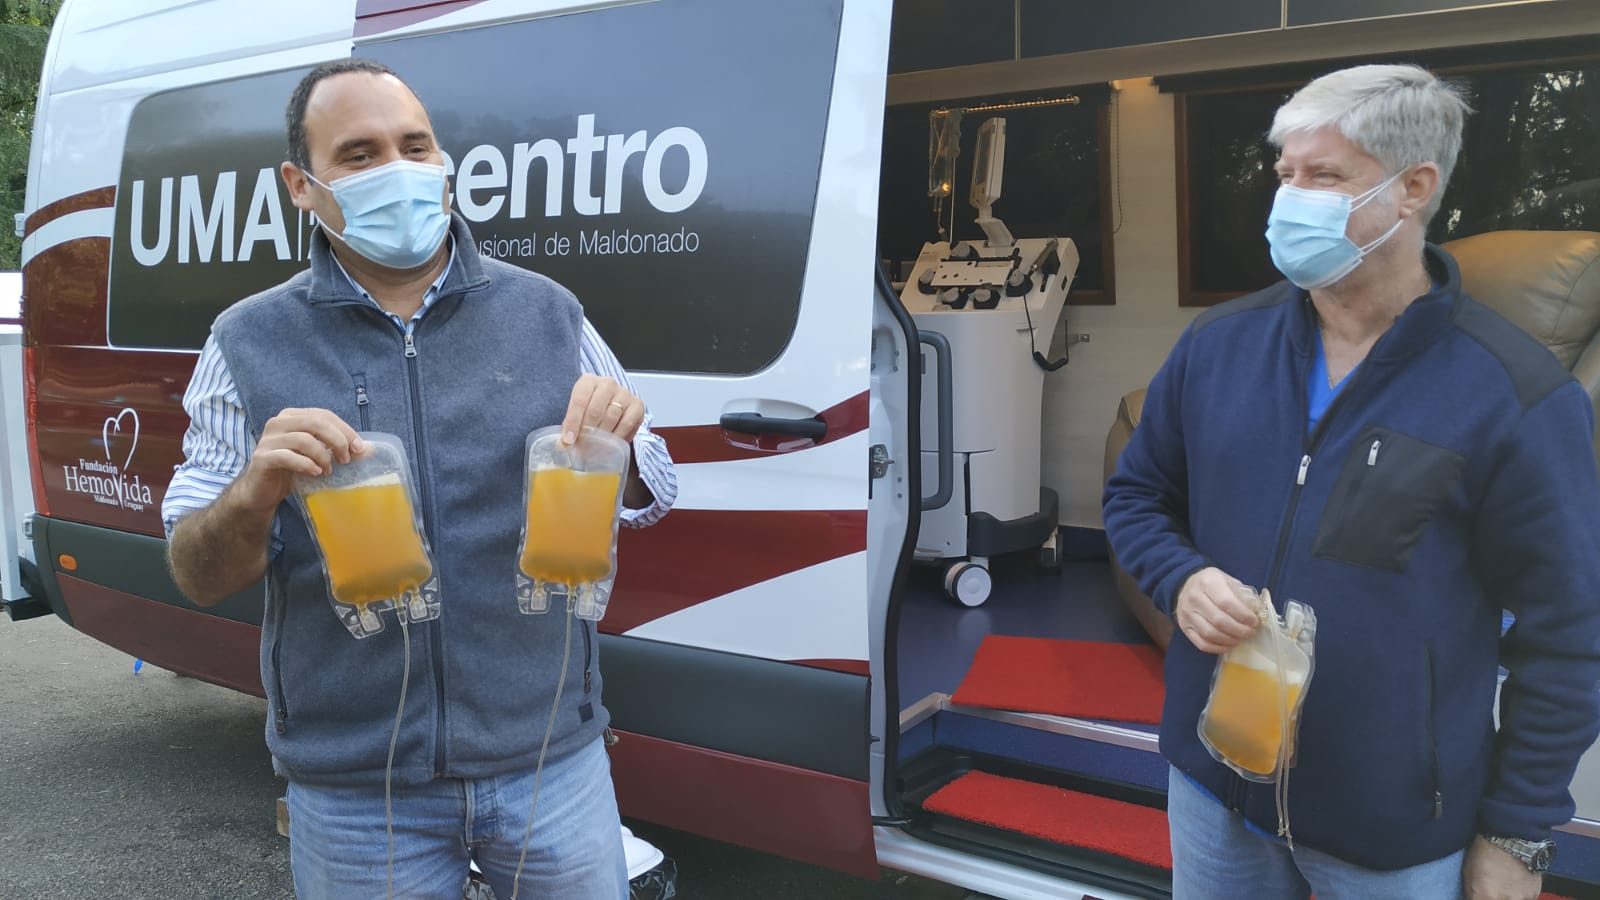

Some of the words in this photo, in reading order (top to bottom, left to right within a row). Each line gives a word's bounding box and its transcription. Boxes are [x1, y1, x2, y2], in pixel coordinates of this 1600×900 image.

[130, 168, 292, 267] UMA
[441, 113, 709, 223] entro
[545, 231, 570, 257] de
[579, 227, 699, 256] Maldonado
[79, 458, 118, 475] Fundación
